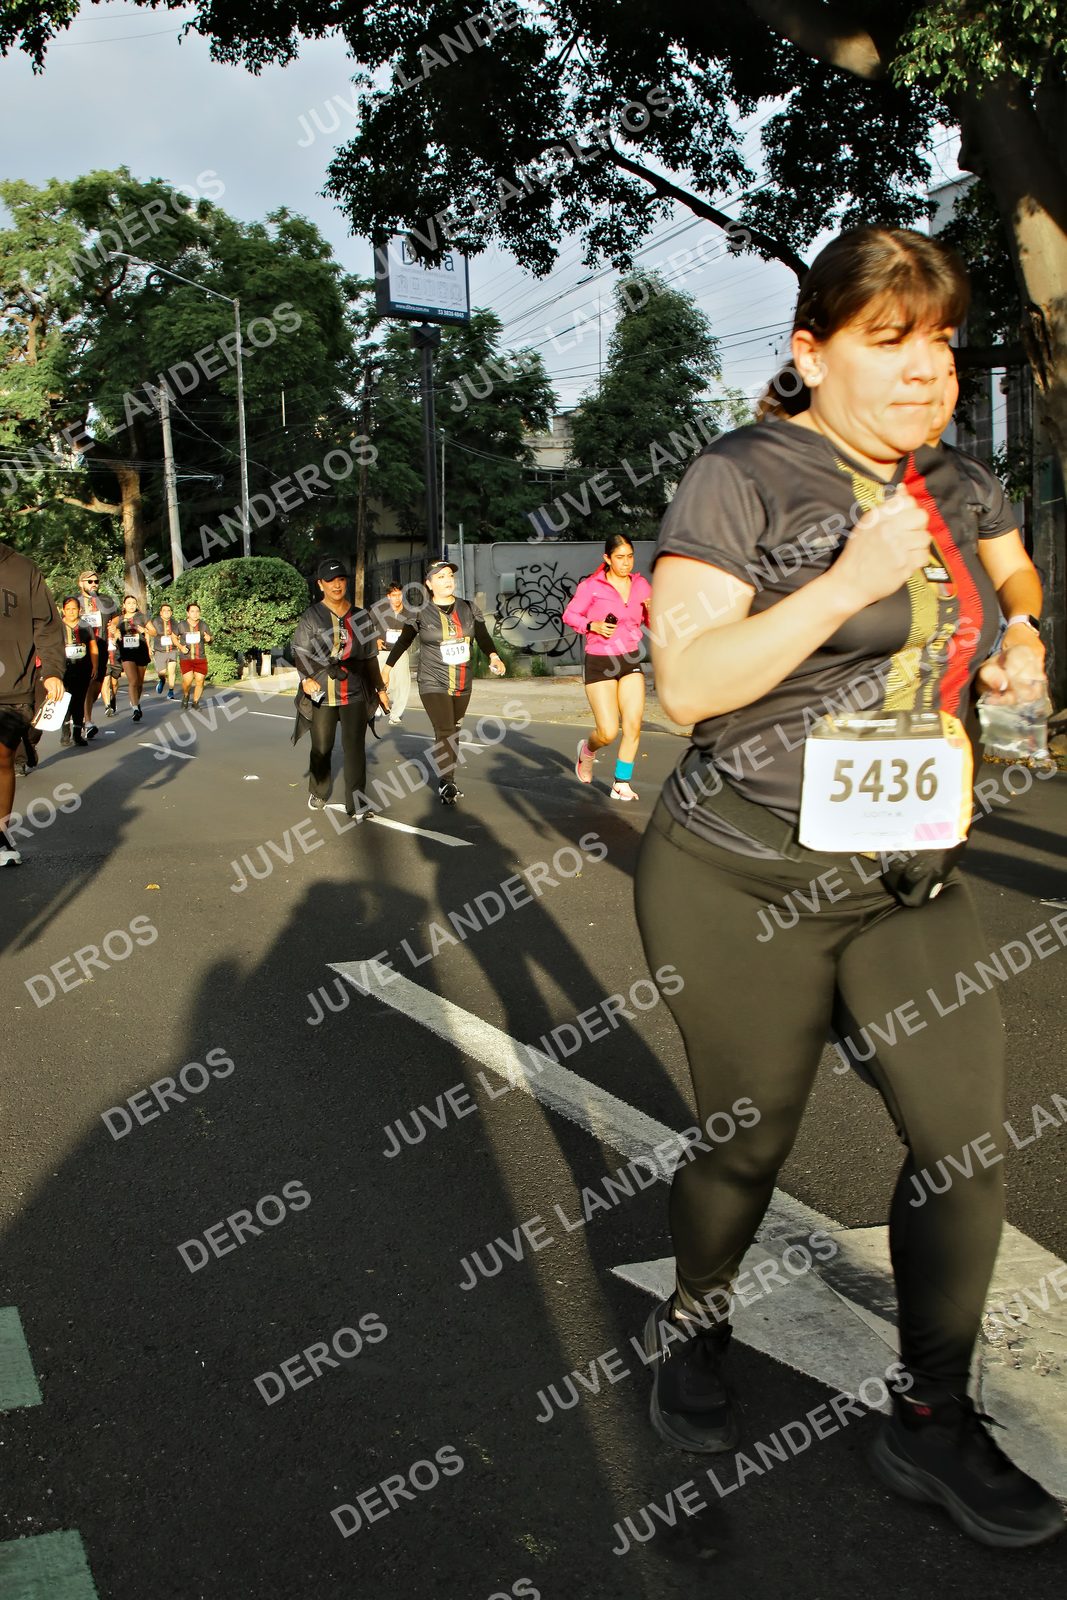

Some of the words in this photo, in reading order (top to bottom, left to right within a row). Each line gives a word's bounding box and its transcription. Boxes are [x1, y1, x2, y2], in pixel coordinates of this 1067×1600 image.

[516, 561, 558, 578] TOY
[445, 645, 465, 656] 4519
[829, 757, 938, 803] 5436
